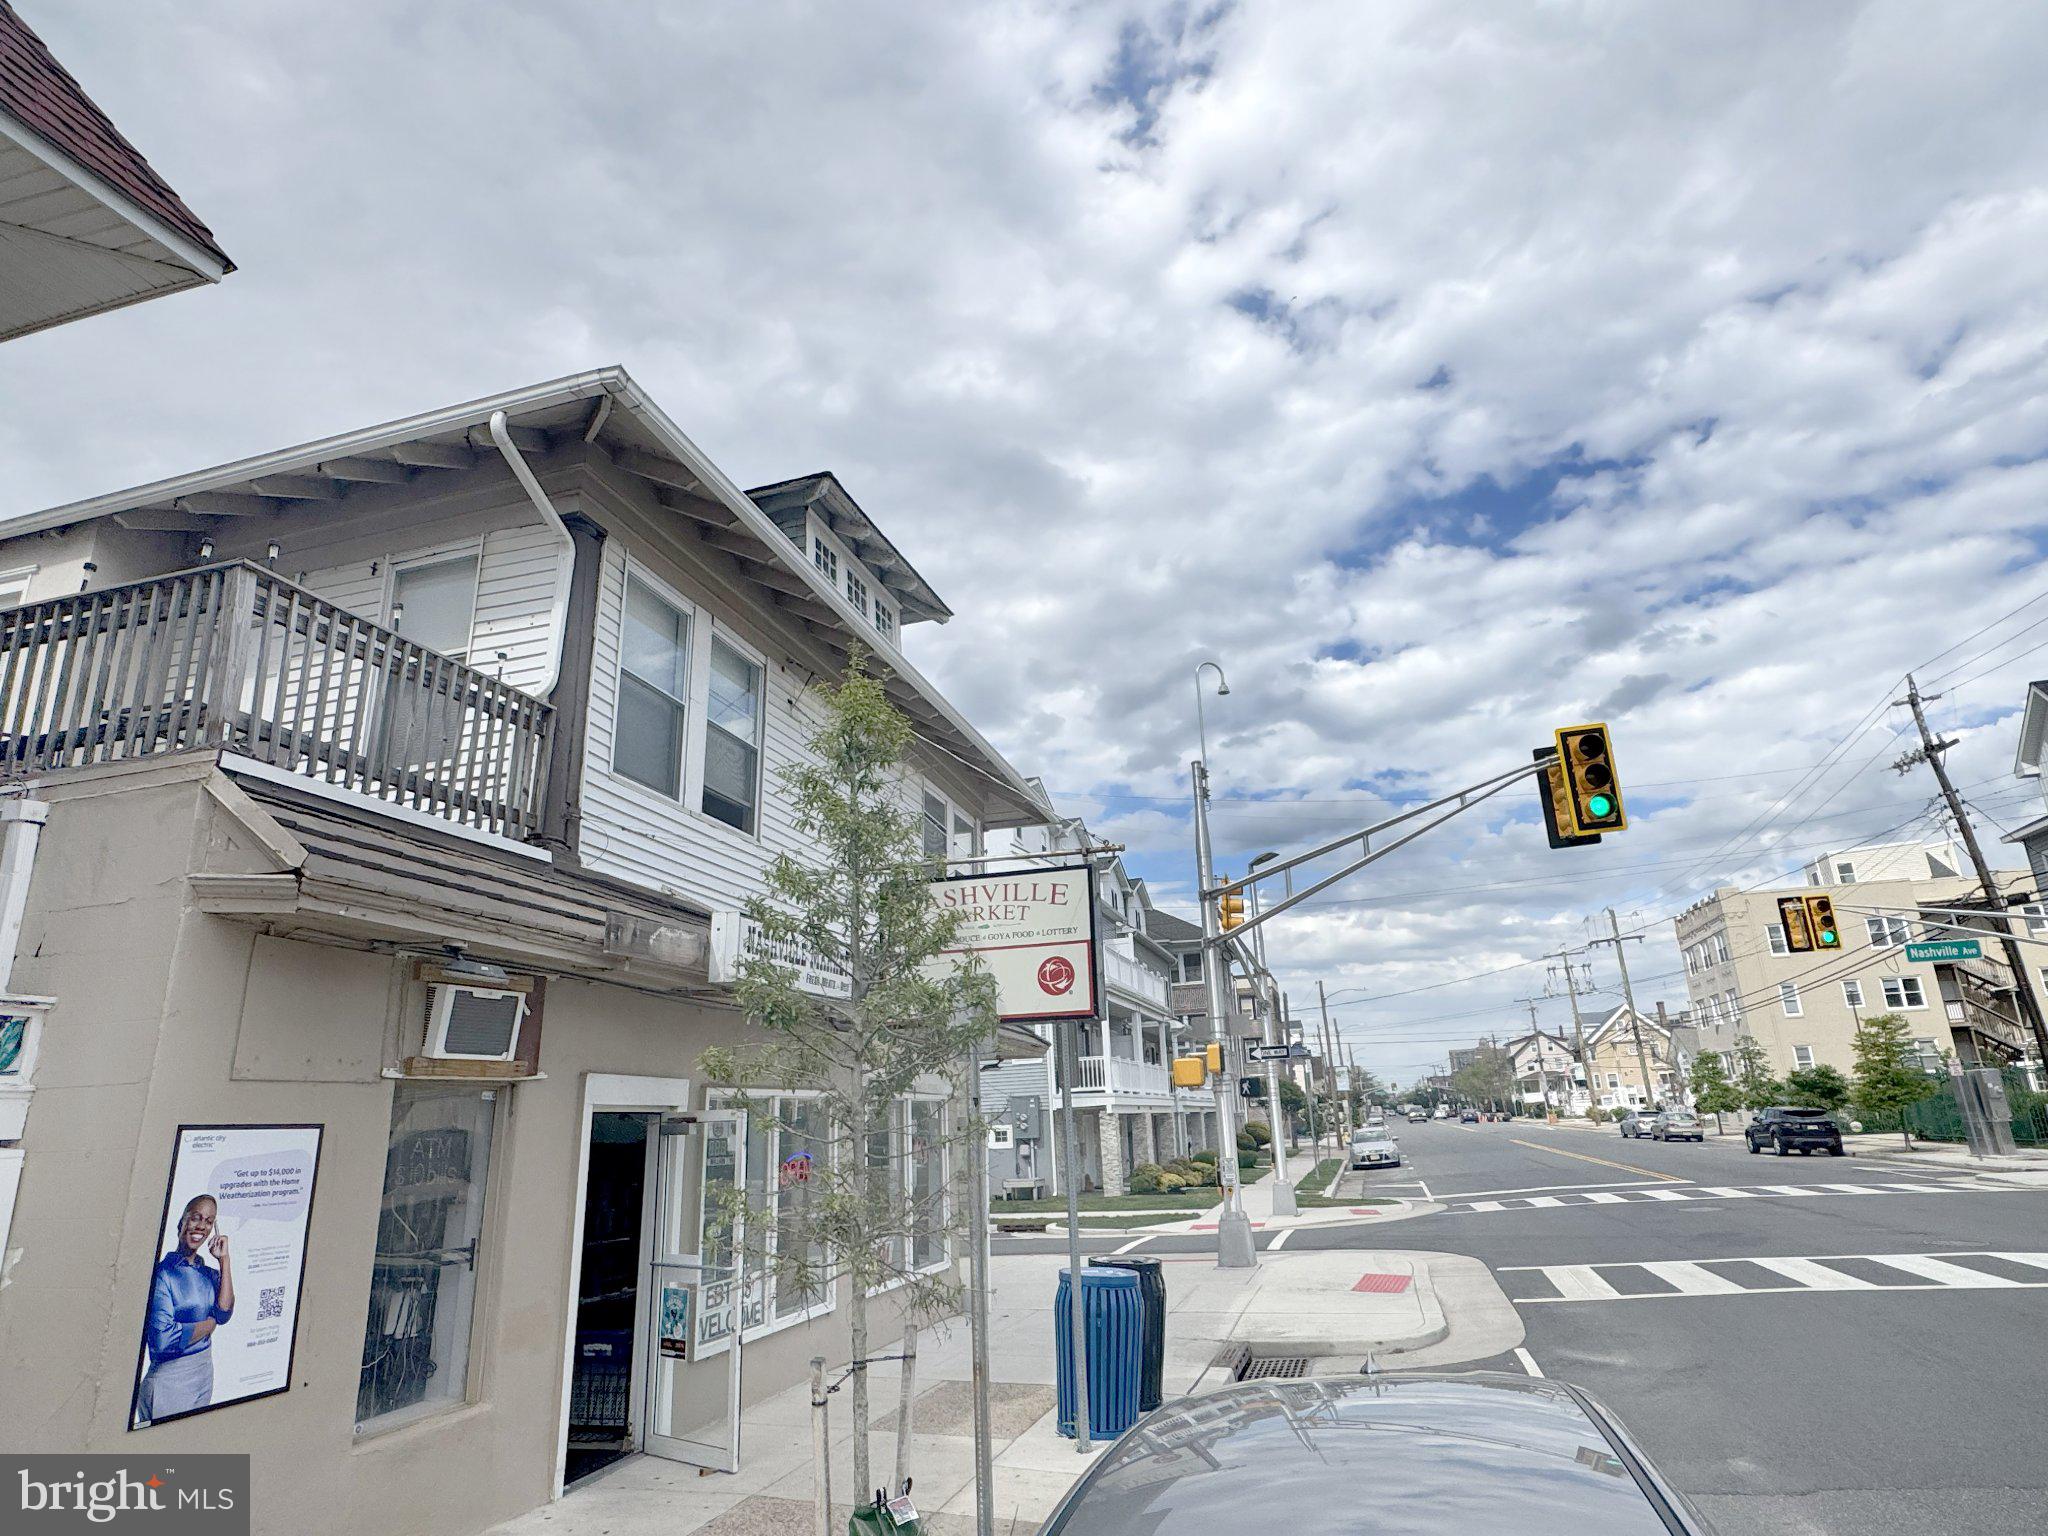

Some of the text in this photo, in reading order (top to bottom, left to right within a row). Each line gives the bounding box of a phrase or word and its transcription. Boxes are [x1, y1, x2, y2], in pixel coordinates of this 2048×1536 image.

[927, 883, 1069, 909] ASHVILLE
[953, 904, 1030, 923] ARKET
[987, 932, 1010, 941] GOYA
[1012, 930, 1034, 939] FOOD
[1041, 927, 1079, 936] LOTTERY
[1909, 946, 1978, 959] Nashville Ave
[250, 1170, 259, 1178] up
[220, 1178, 300, 1191] upgrades with the Home
[219, 1190, 270, 1200] Weatherization
[699, 1301, 761, 1340] ELCME
